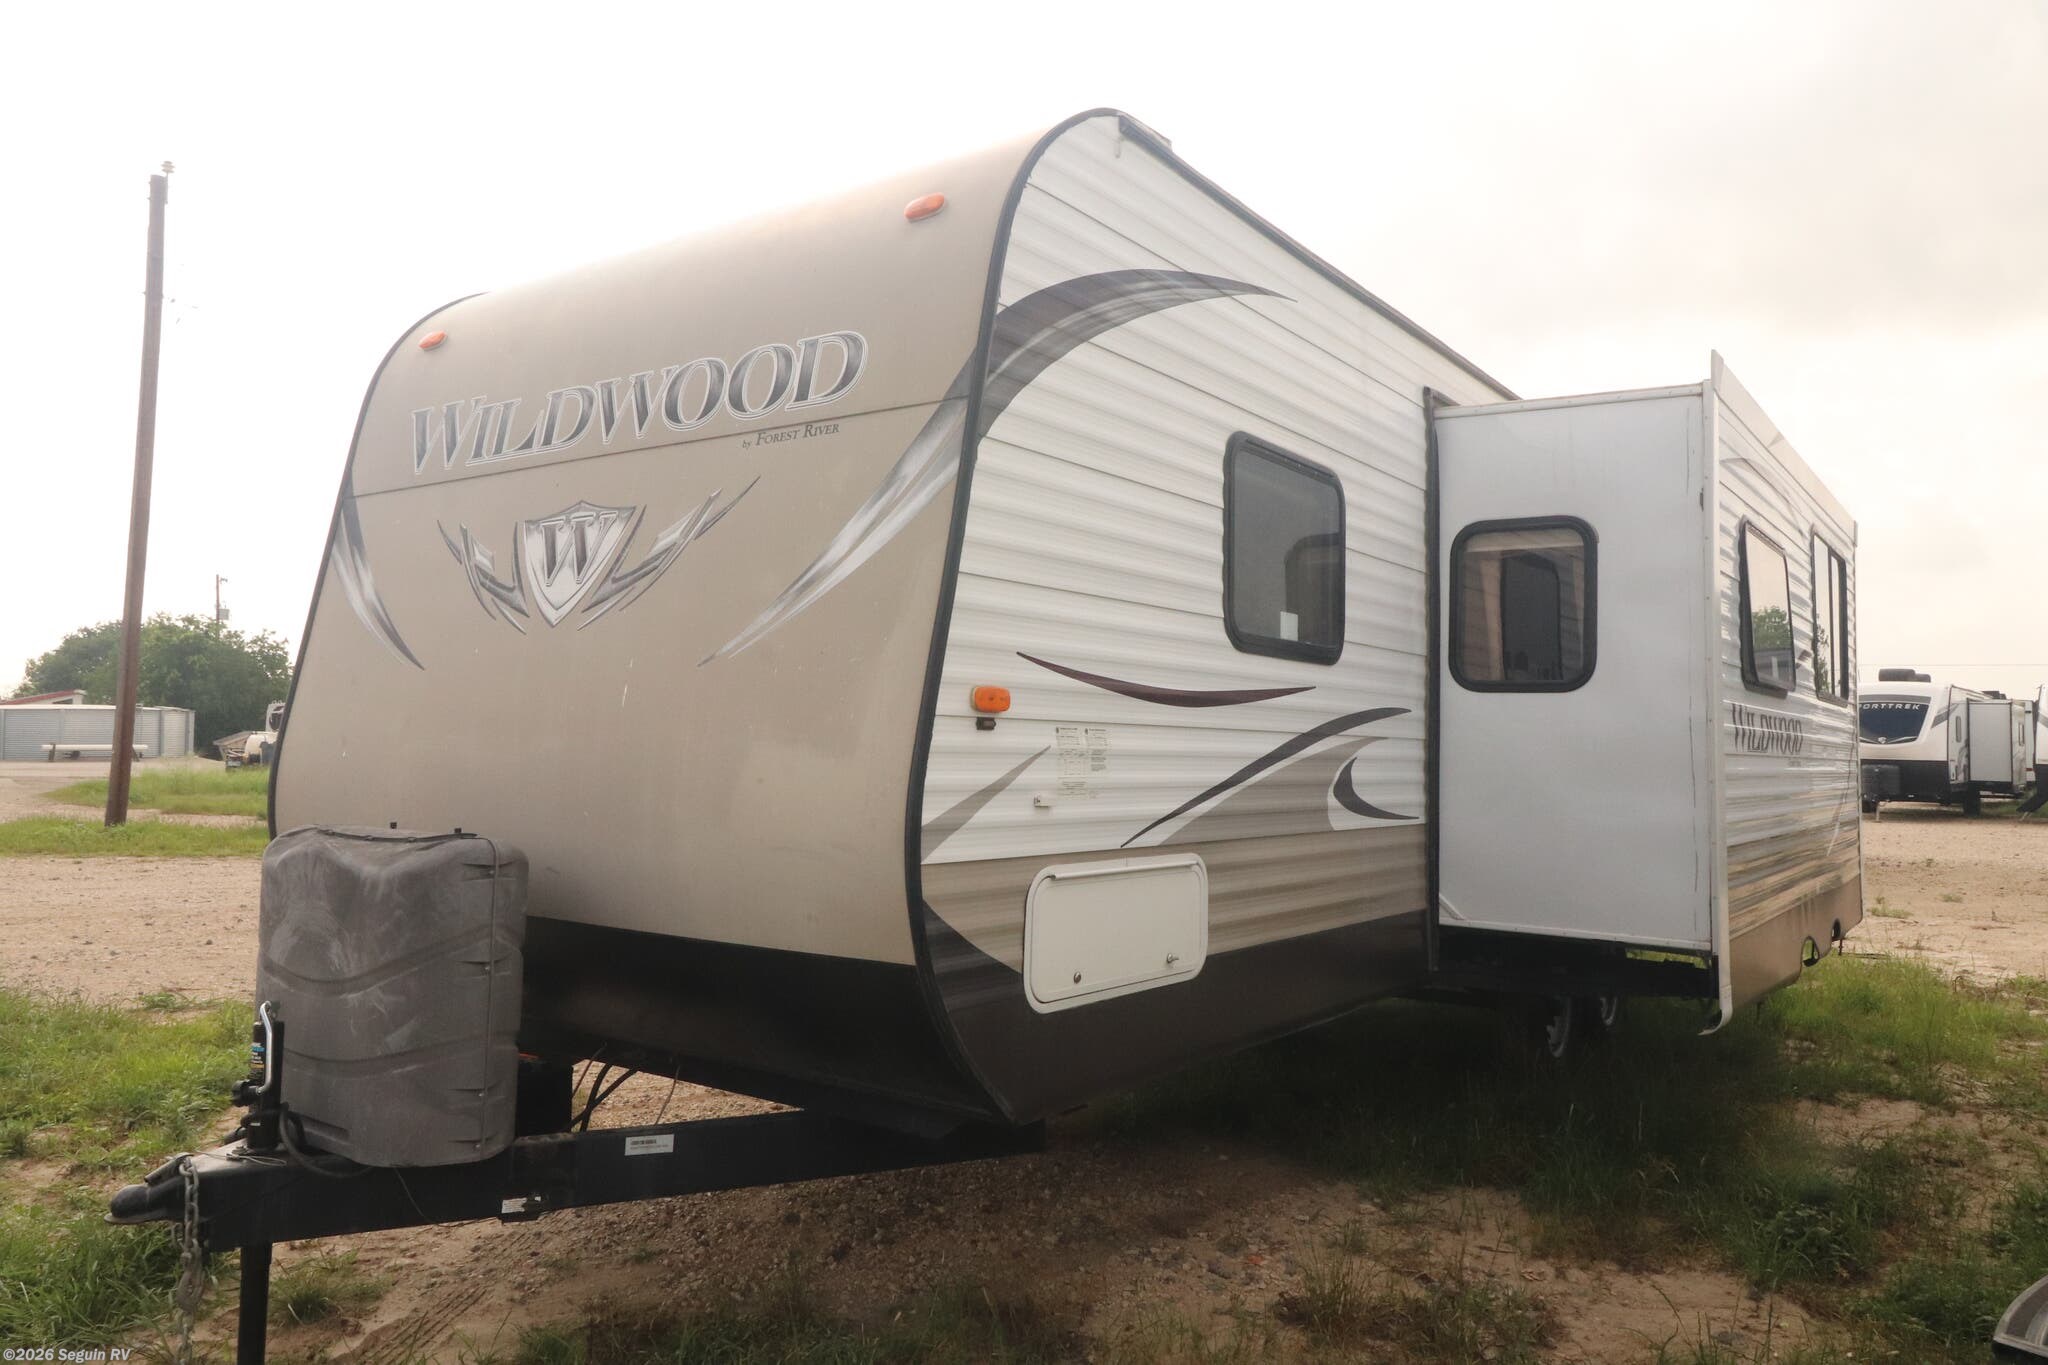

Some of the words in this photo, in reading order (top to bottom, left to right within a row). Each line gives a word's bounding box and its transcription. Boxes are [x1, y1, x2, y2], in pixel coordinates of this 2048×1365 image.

[412, 330, 868, 475] WILDWOOD
[742, 440, 753, 450] by
[756, 430, 800, 446] FOREST
[803, 424, 839, 438] RIVER
[1731, 703, 1803, 755] WILDWOOD
